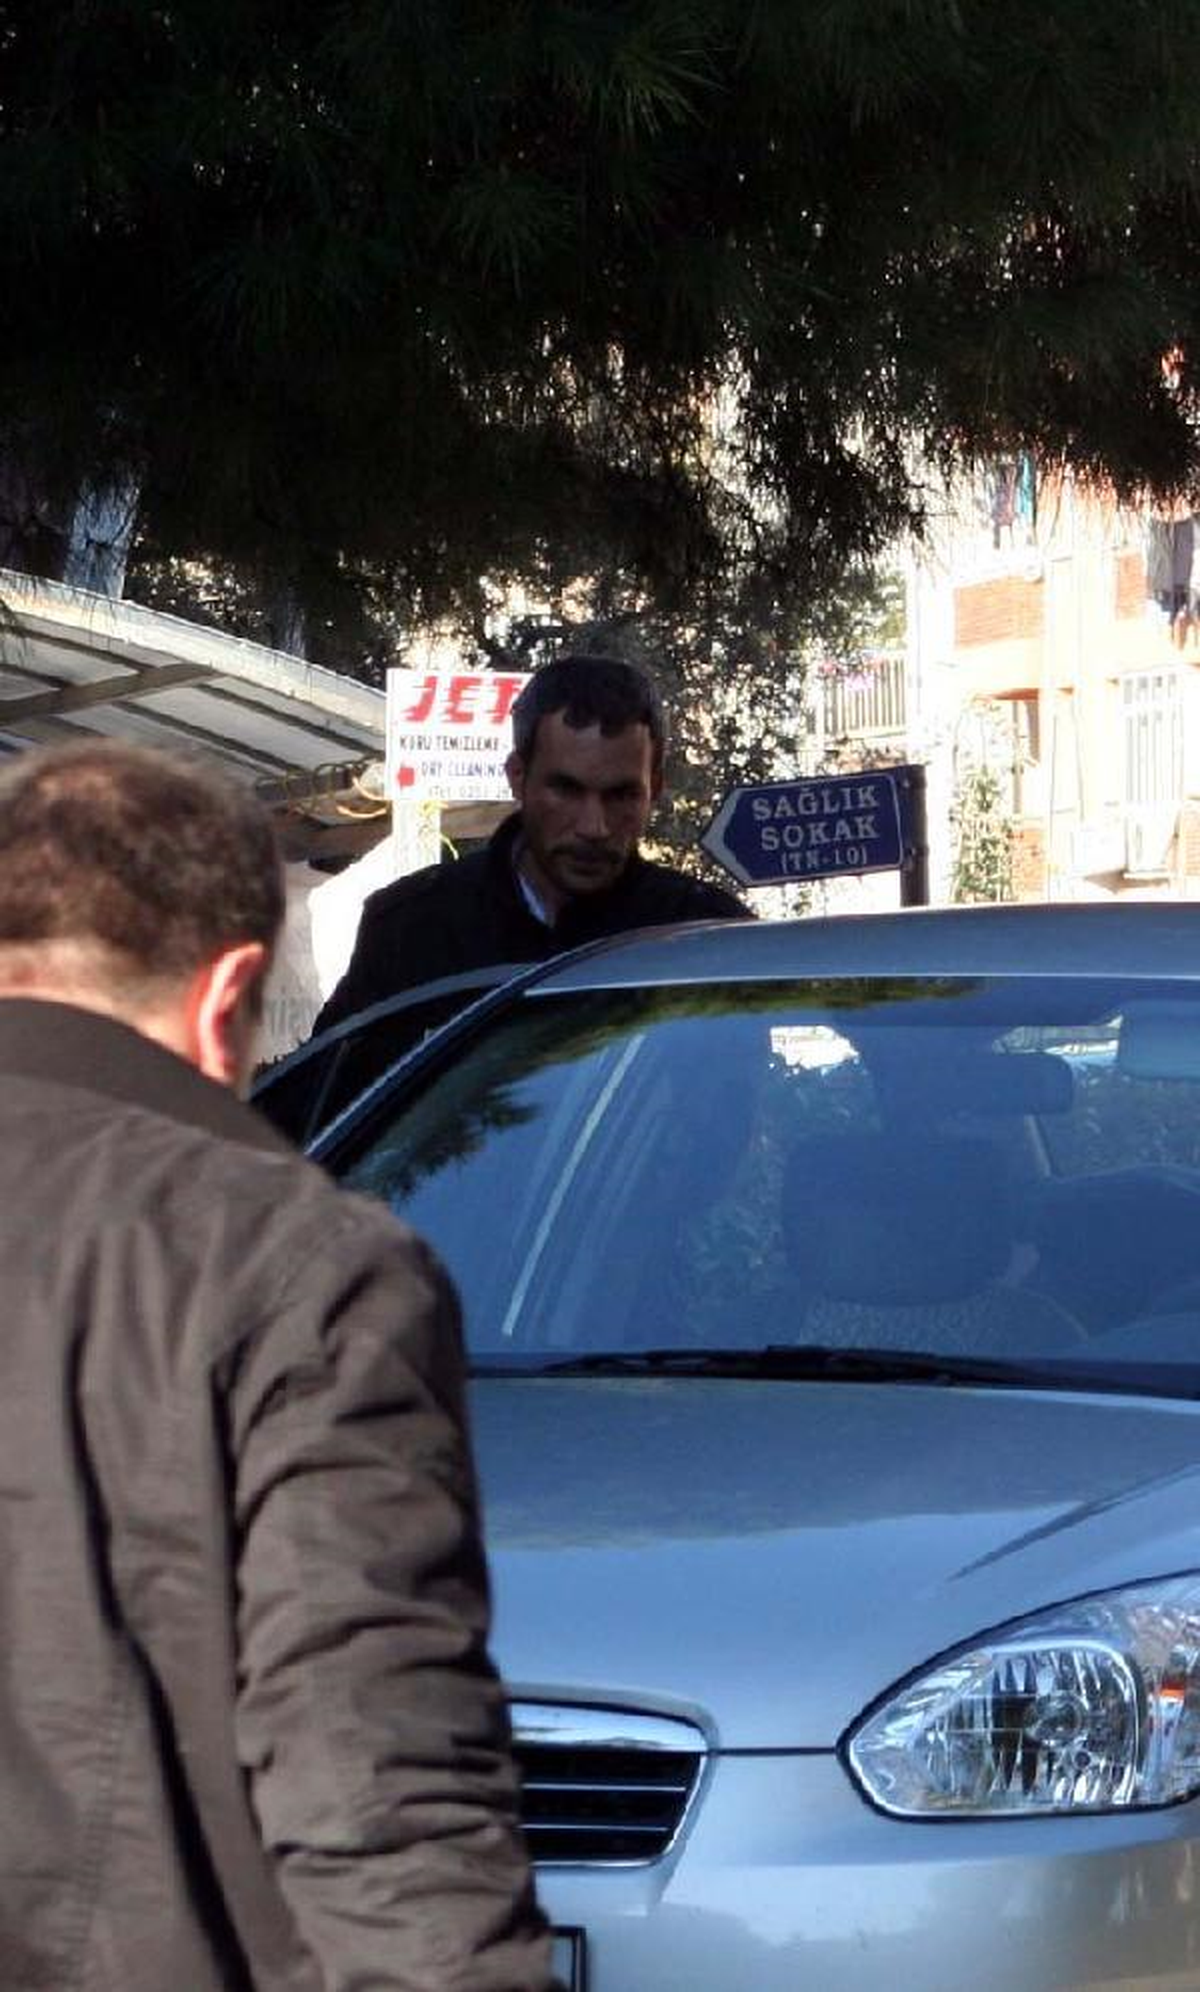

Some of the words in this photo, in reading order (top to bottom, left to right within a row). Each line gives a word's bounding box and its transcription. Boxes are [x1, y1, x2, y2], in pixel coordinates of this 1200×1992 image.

[401, 676, 522, 724] JET
[400, 736, 432, 751] KURU
[752, 785, 879, 821] SAĞLIK
[761, 815, 879, 850] SOKAK
